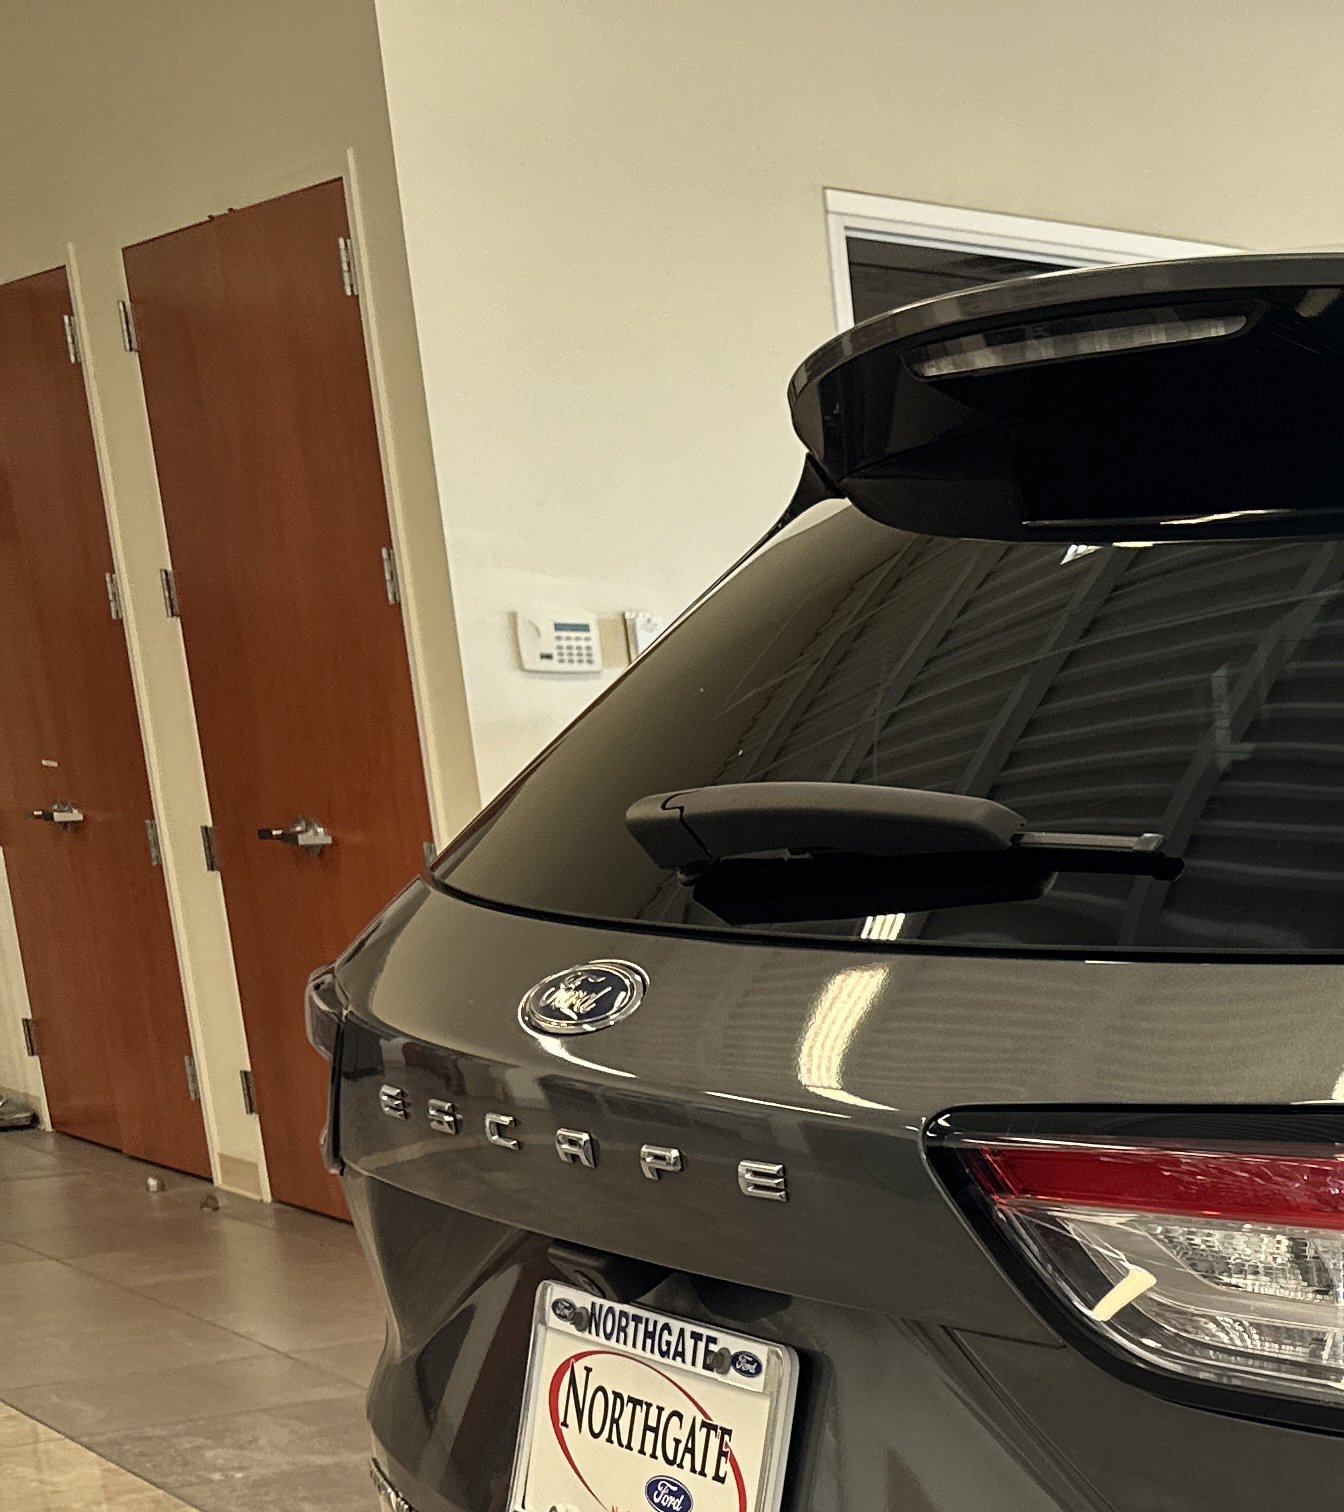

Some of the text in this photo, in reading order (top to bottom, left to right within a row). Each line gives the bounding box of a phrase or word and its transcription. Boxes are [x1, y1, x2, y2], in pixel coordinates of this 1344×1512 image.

[379, 1084, 788, 1202] ESCAPE
[588, 1301, 719, 1373] NORTHGATE
[735, 1352, 757, 1374] Ford
[560, 1359, 733, 1485] NORTHGATE
[653, 1480, 685, 1512] Ford
